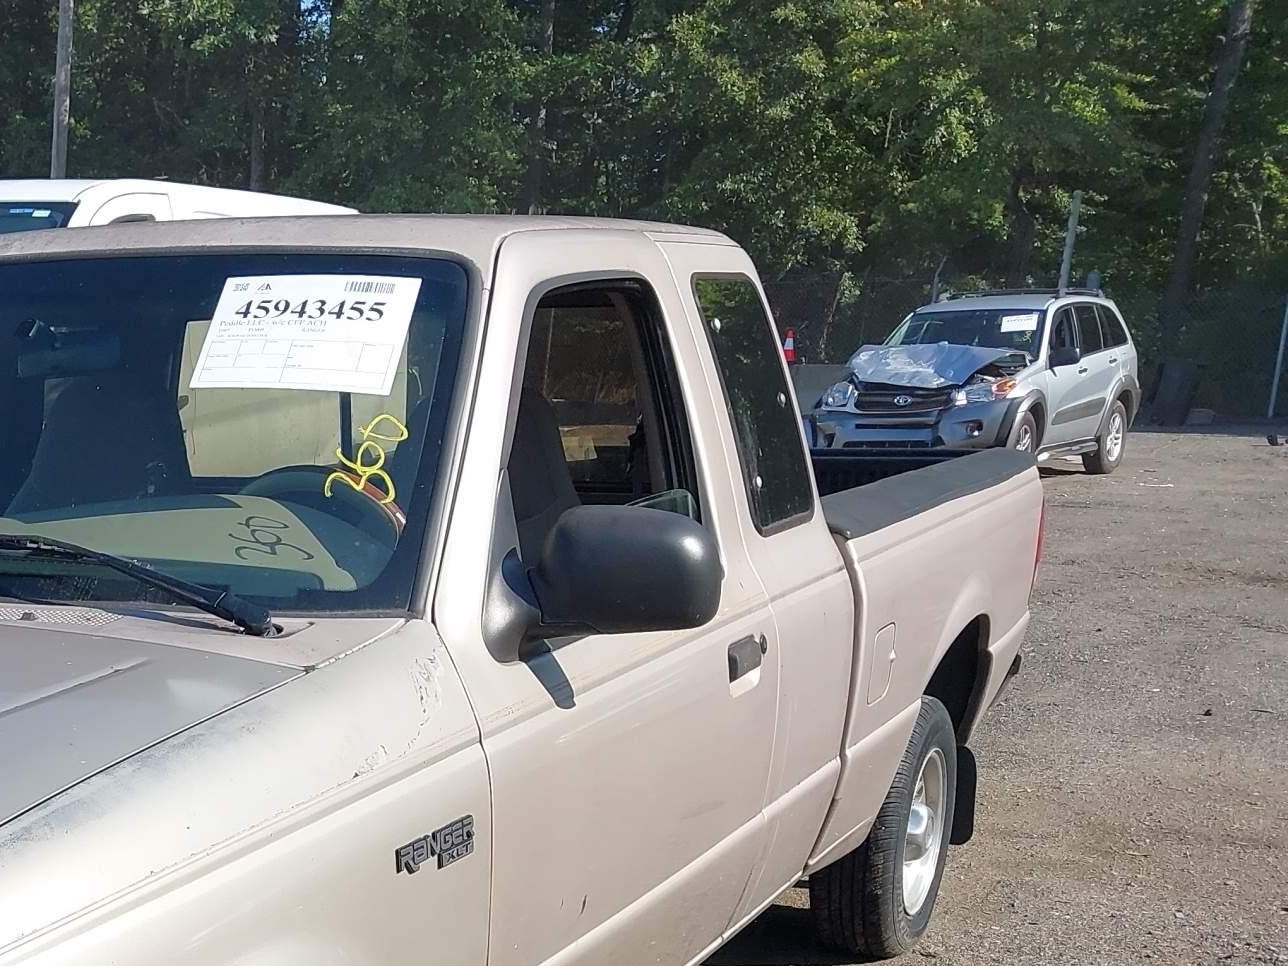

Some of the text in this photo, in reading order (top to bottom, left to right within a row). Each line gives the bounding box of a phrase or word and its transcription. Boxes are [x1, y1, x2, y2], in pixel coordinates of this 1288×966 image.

[235, 299, 387, 321] 45943455
[395, 814, 474, 875] RANGER
[443, 841, 472, 865] XLT
